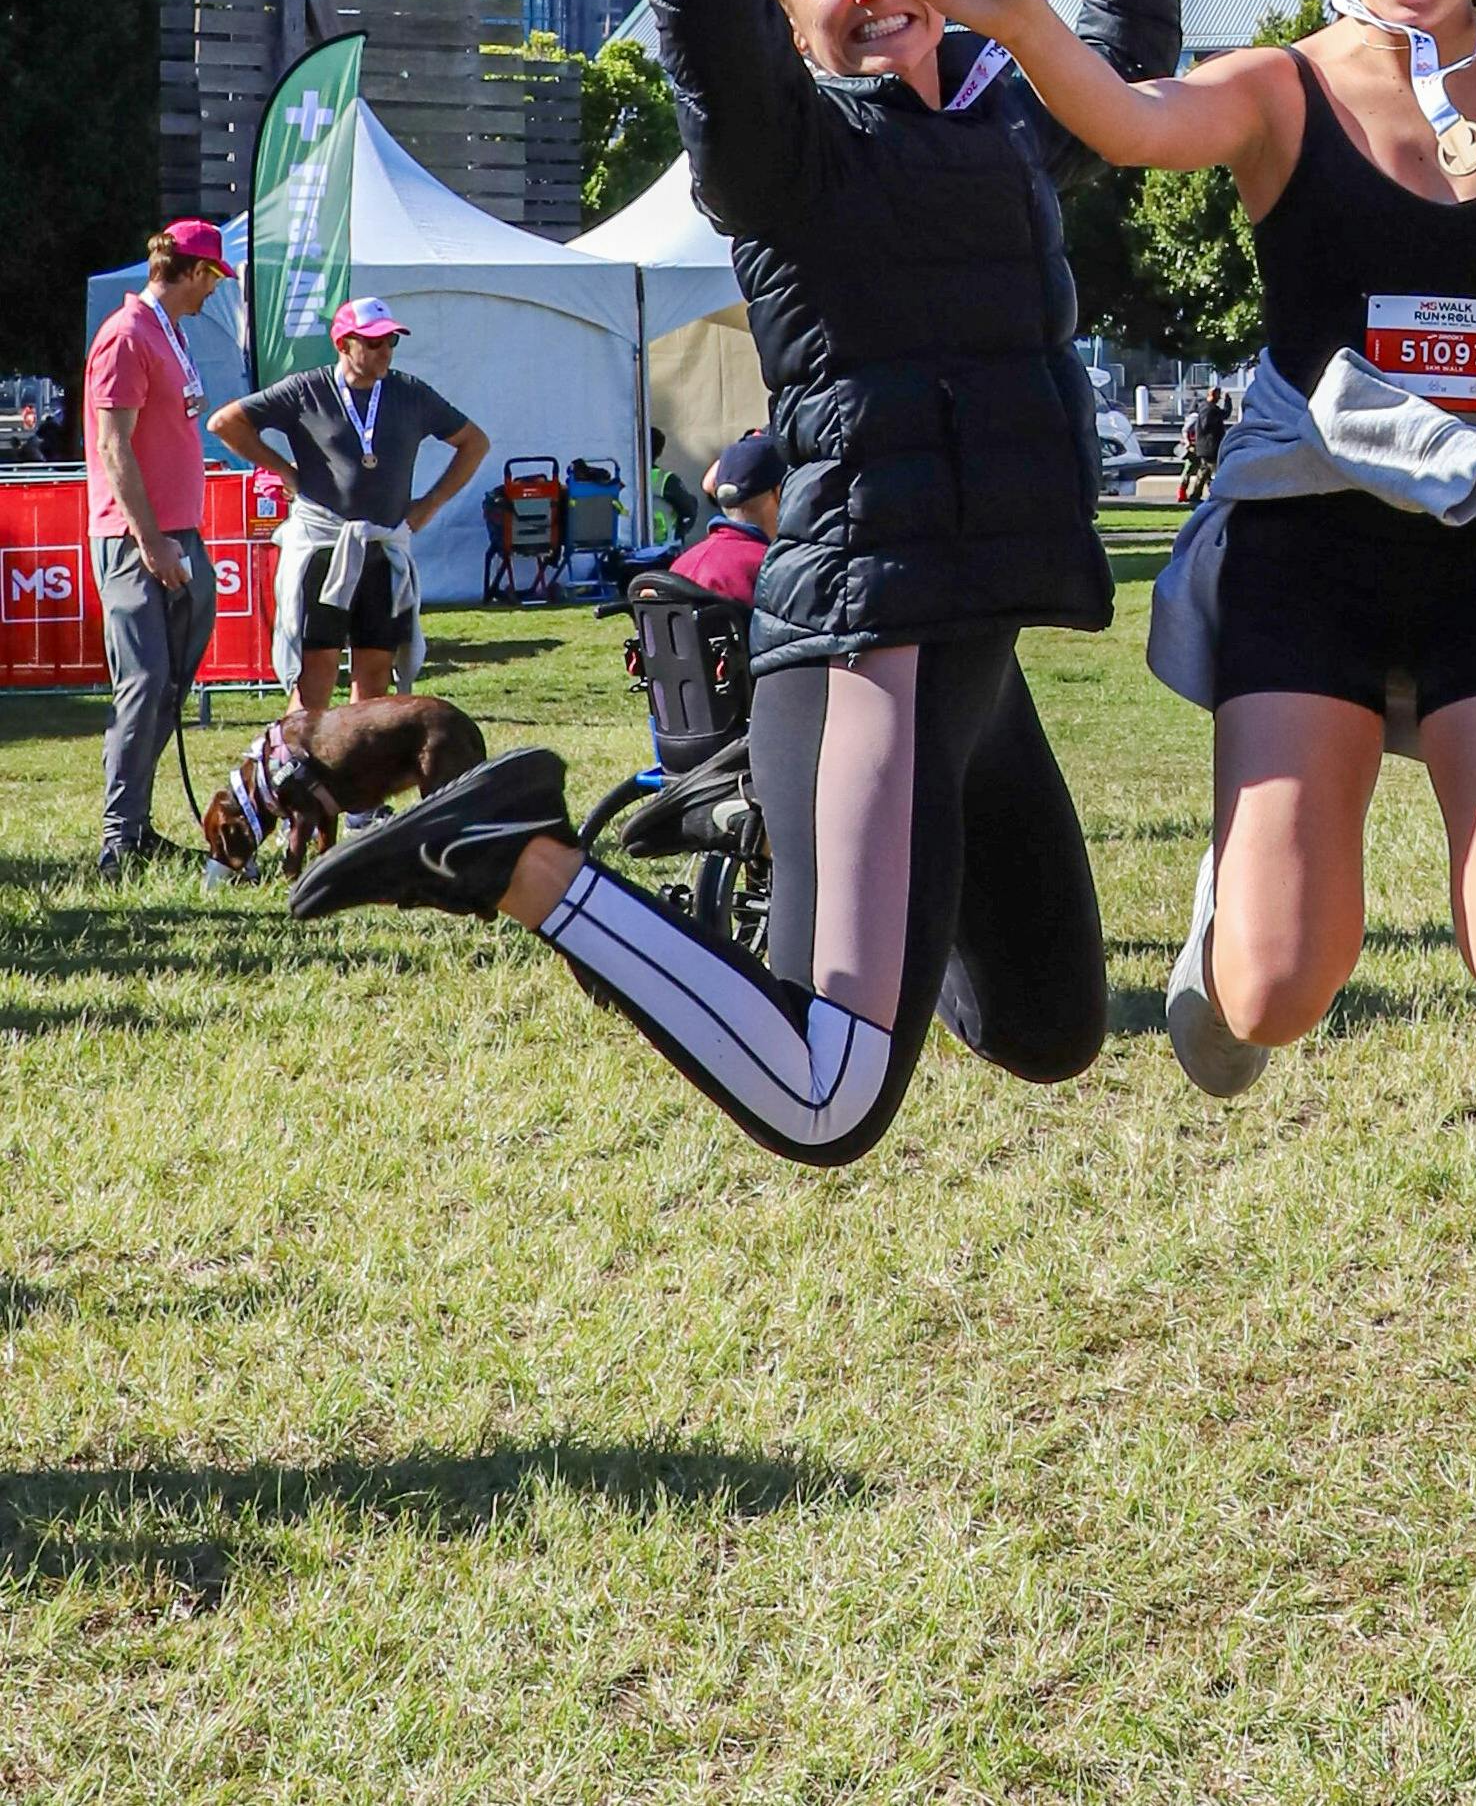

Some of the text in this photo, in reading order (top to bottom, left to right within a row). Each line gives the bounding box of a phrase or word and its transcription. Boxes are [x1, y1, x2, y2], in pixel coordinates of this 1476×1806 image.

[1420, 301, 1473, 313] MS WALK
[11, 565, 72, 601] MS
[215, 559, 241, 595] S
